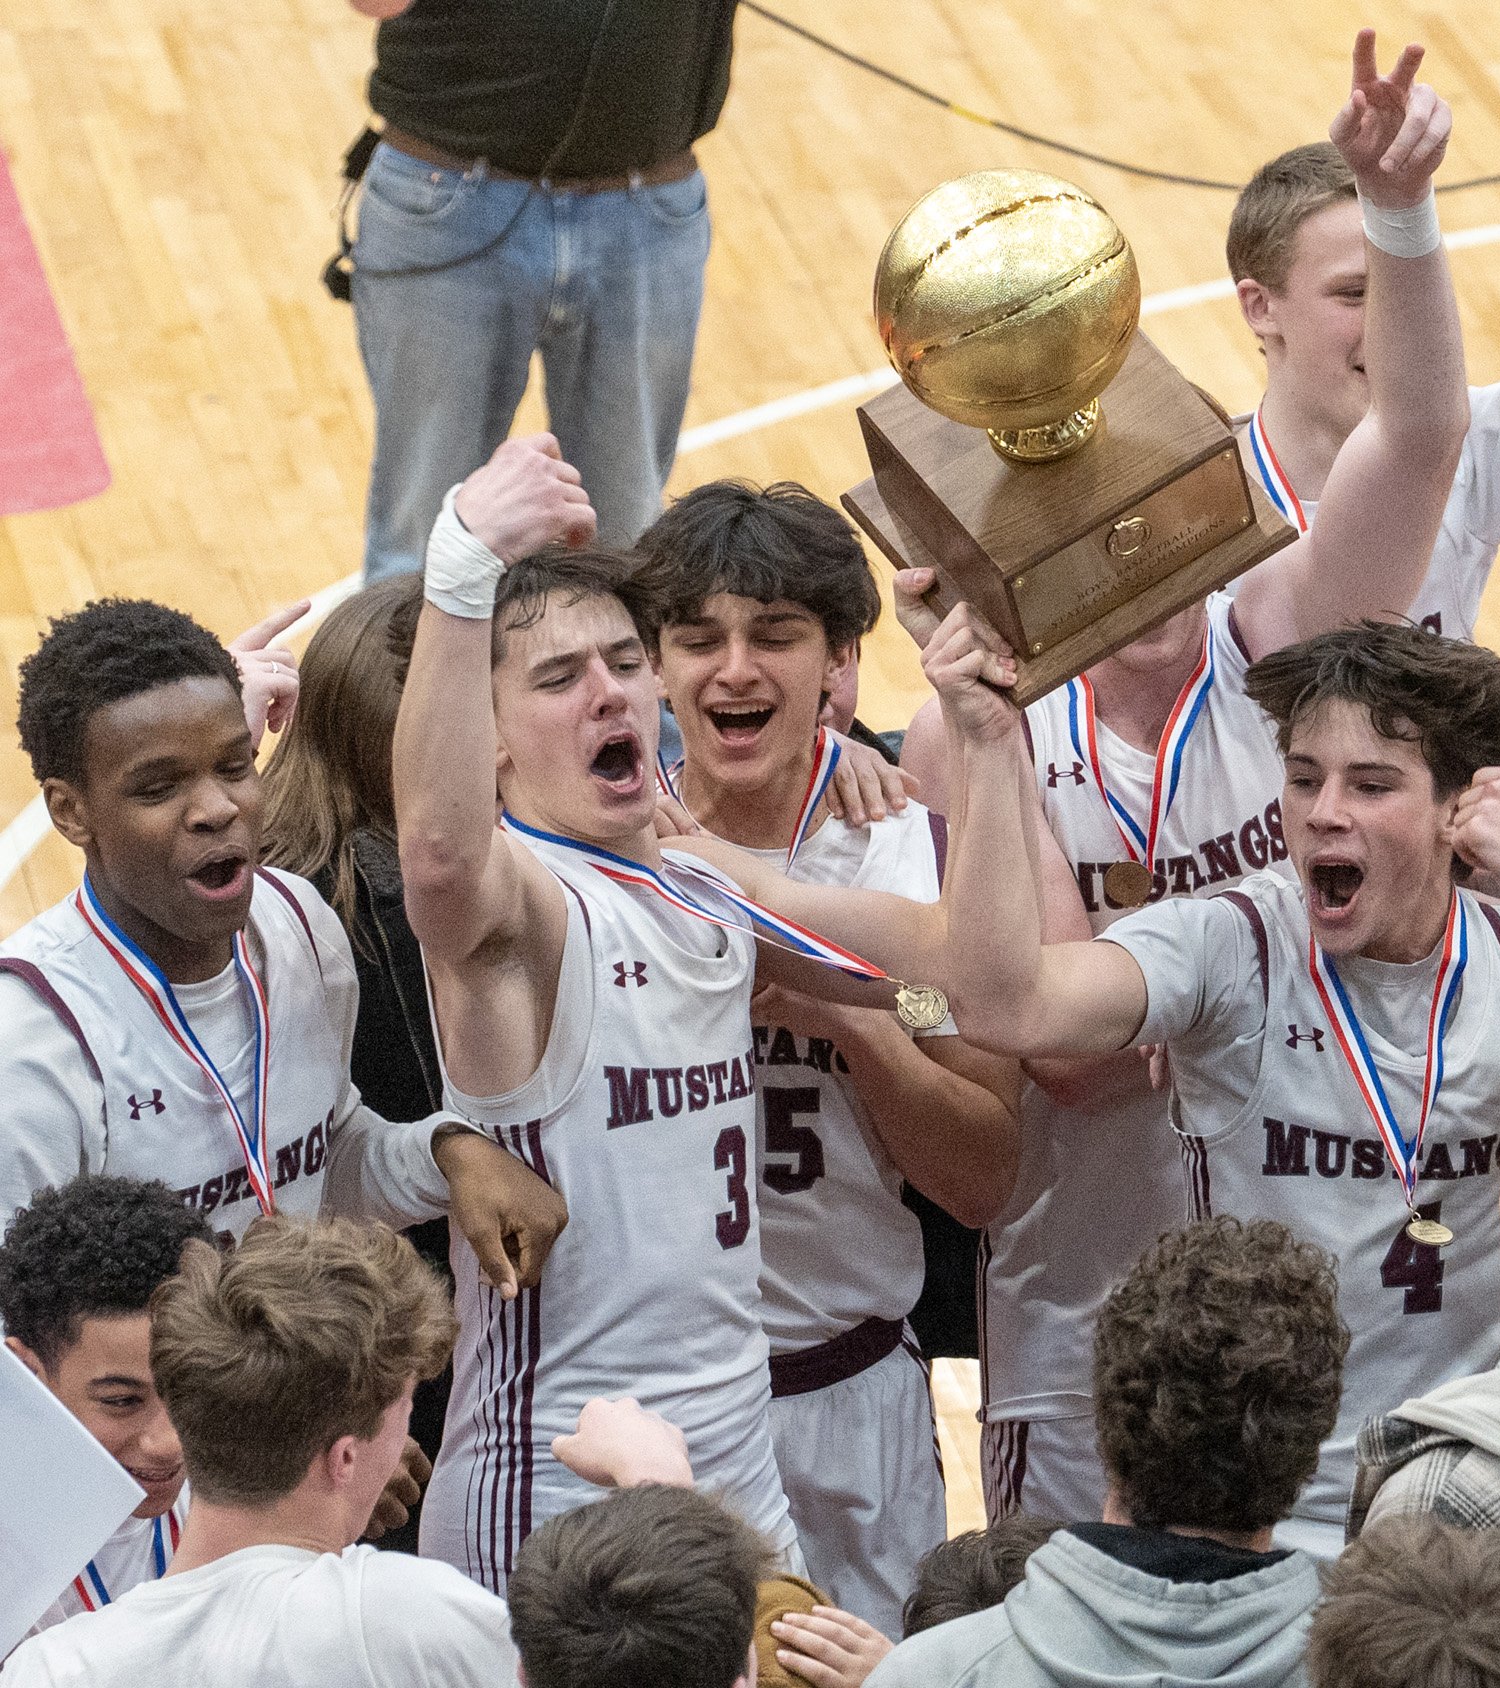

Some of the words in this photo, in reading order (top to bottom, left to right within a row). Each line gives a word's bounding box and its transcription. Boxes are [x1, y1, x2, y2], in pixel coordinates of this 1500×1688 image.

[1092, 576, 1133, 604] CLASS
[1146, 517, 1227, 570] CHAMPIONS
[1115, 525, 1195, 579] BASKETBALL
[713, 1125, 751, 1251] 3
[1380, 1201, 1445, 1315] 4
